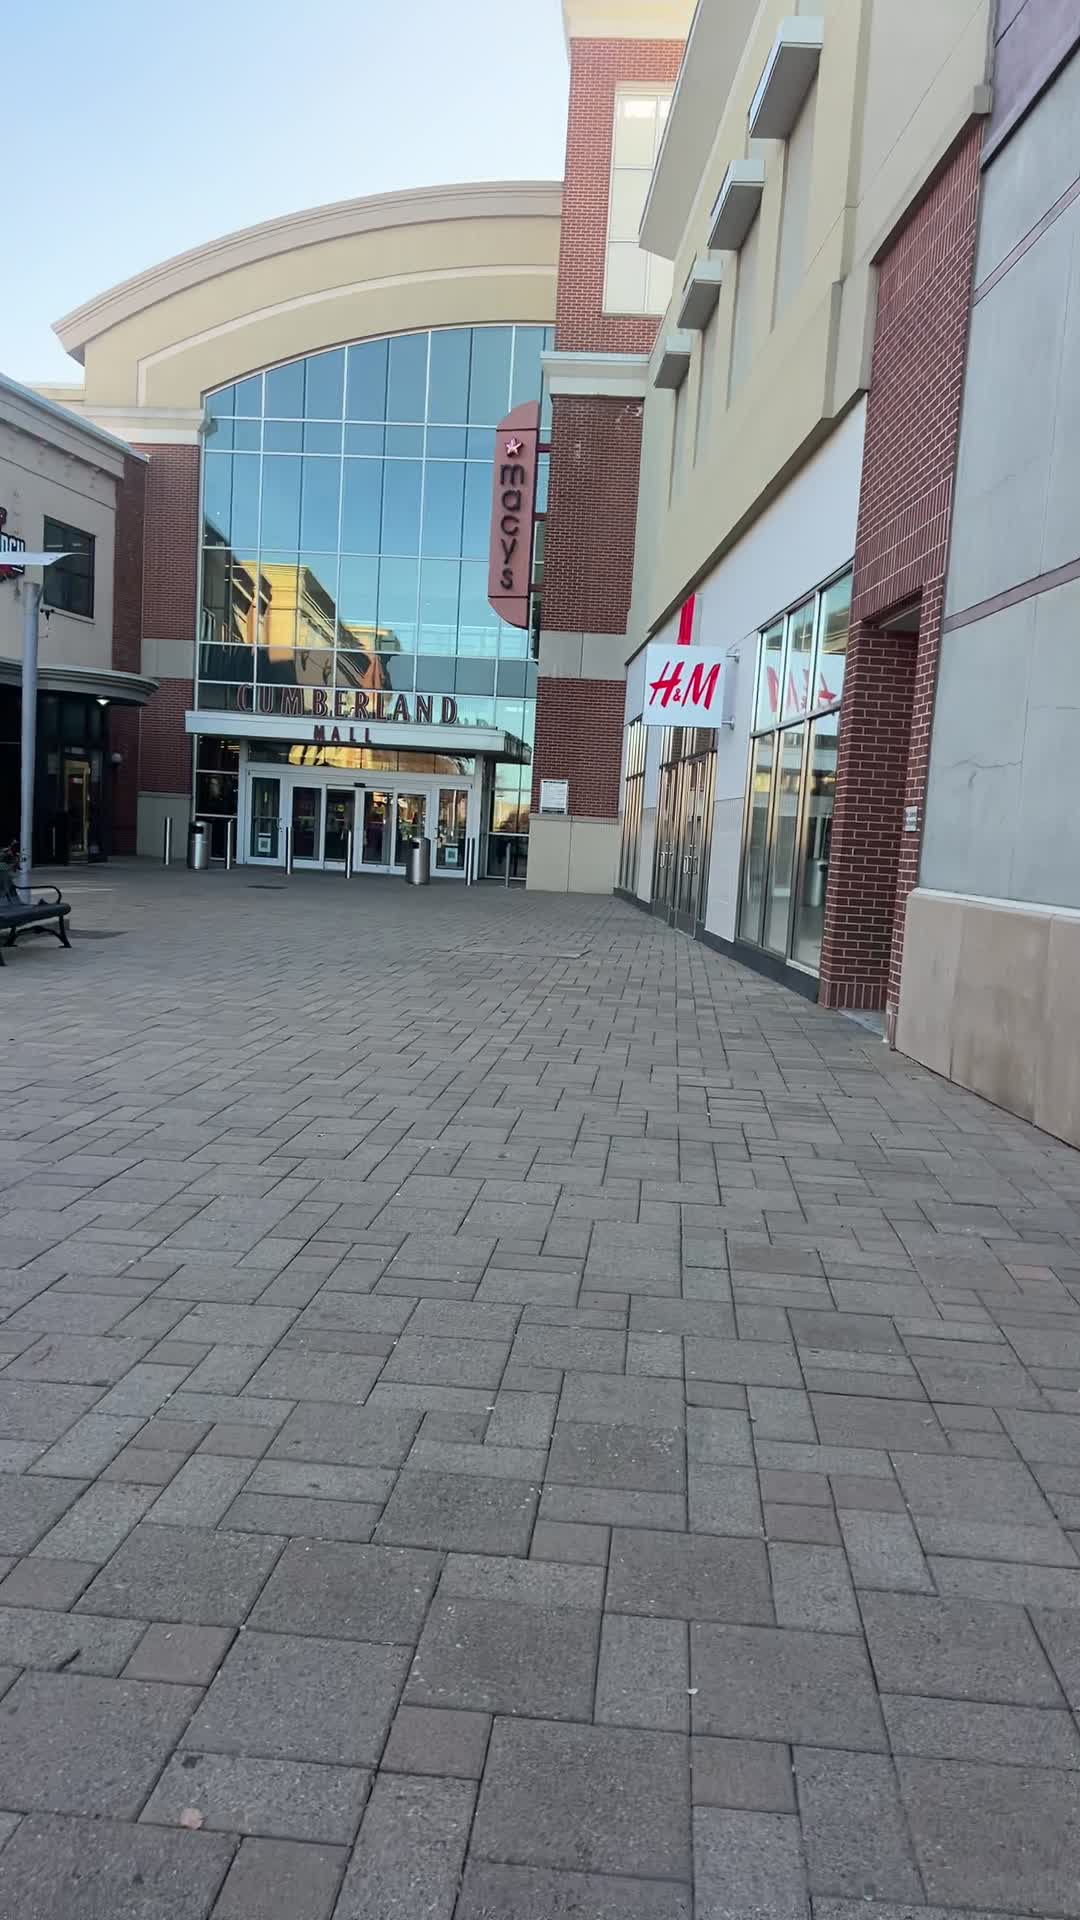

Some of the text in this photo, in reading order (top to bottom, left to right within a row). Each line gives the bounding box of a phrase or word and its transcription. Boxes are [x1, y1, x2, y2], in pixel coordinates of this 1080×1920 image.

[237, 684, 458, 725] CUMBERLAND
[649, 661, 721, 711] H&M
[313, 725, 372, 743] MALL
